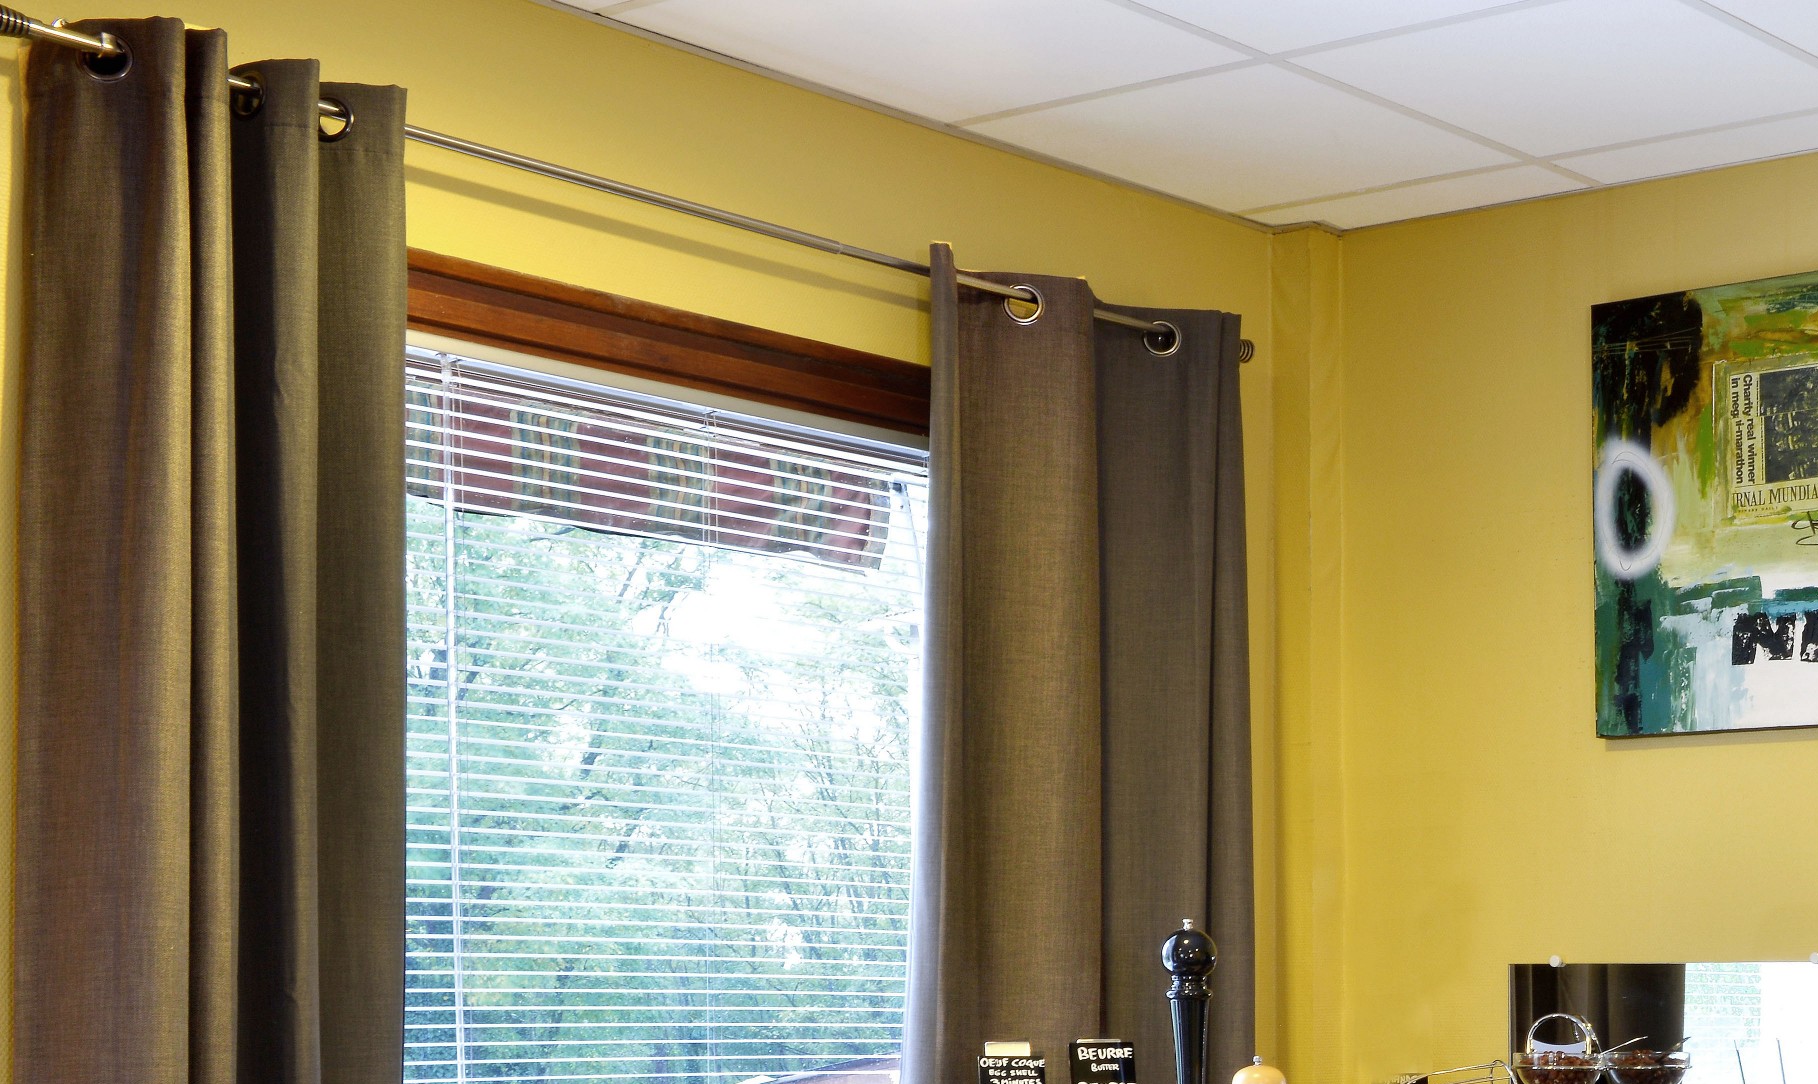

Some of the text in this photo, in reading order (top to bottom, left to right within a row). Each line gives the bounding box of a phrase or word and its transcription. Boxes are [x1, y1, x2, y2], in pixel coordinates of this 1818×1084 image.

[1731, 377, 1740, 388] in
[1742, 374, 1757, 484] Charity real winner
[1077, 1047, 1133, 1061] BEURRE
[979, 1057, 1045, 1068] OEUF COQUE
